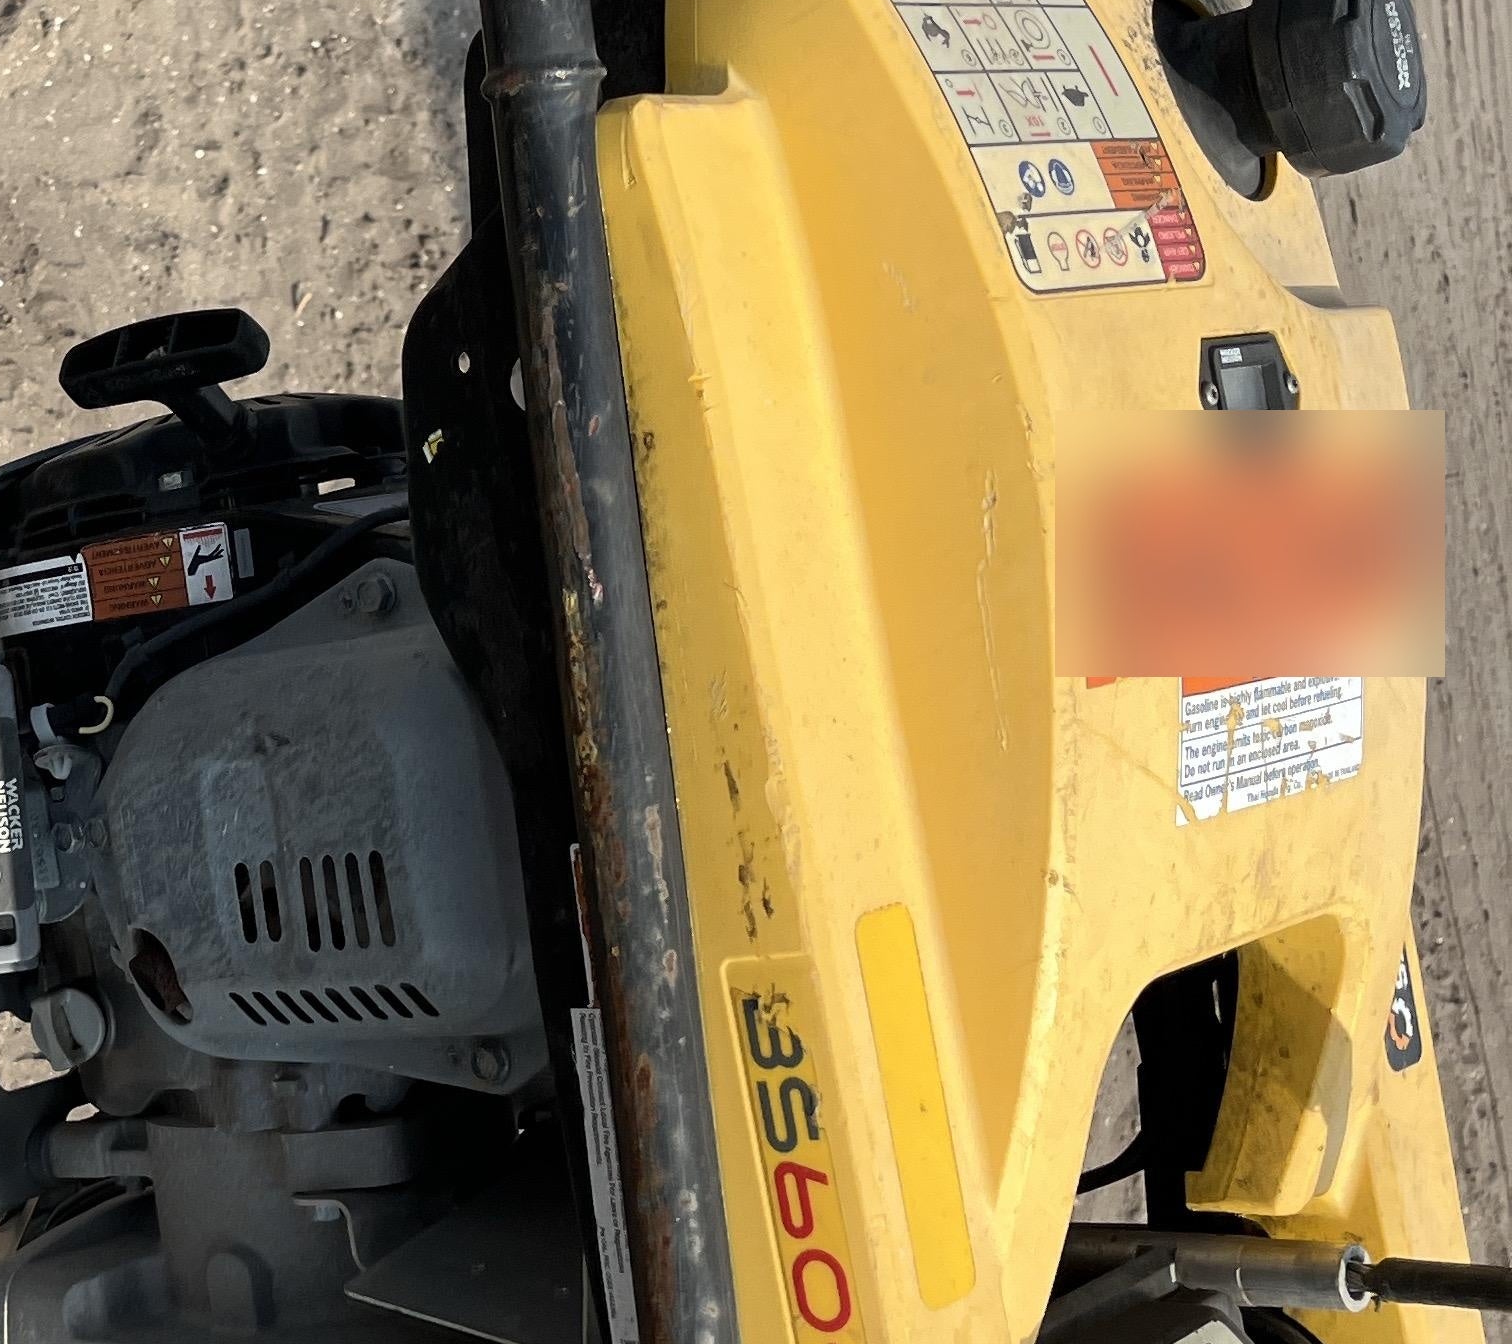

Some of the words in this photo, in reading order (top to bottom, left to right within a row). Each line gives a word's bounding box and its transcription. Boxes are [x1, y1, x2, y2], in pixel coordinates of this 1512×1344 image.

[1185, 698, 1219, 716] Gasoline
[1253, 681, 1292, 702] flammable
[1294, 677, 1306, 692] and
[1246, 704, 1260, 721] and
[1262, 703, 1272, 717] let
[1273, 697, 1288, 713] cool
[1290, 693, 1312, 710] before
[1185, 745, 1200, 760] The
[1201, 739, 1228, 758] engine
[1184, 764, 1196, 779] Do
[1197, 760, 1211, 775] not
[1212, 758, 1226, 771] run
[1236, 770, 1263, 790] Manual
[1264, 766, 1287, 784] before
[6, 778, 24, 851] WACKER
